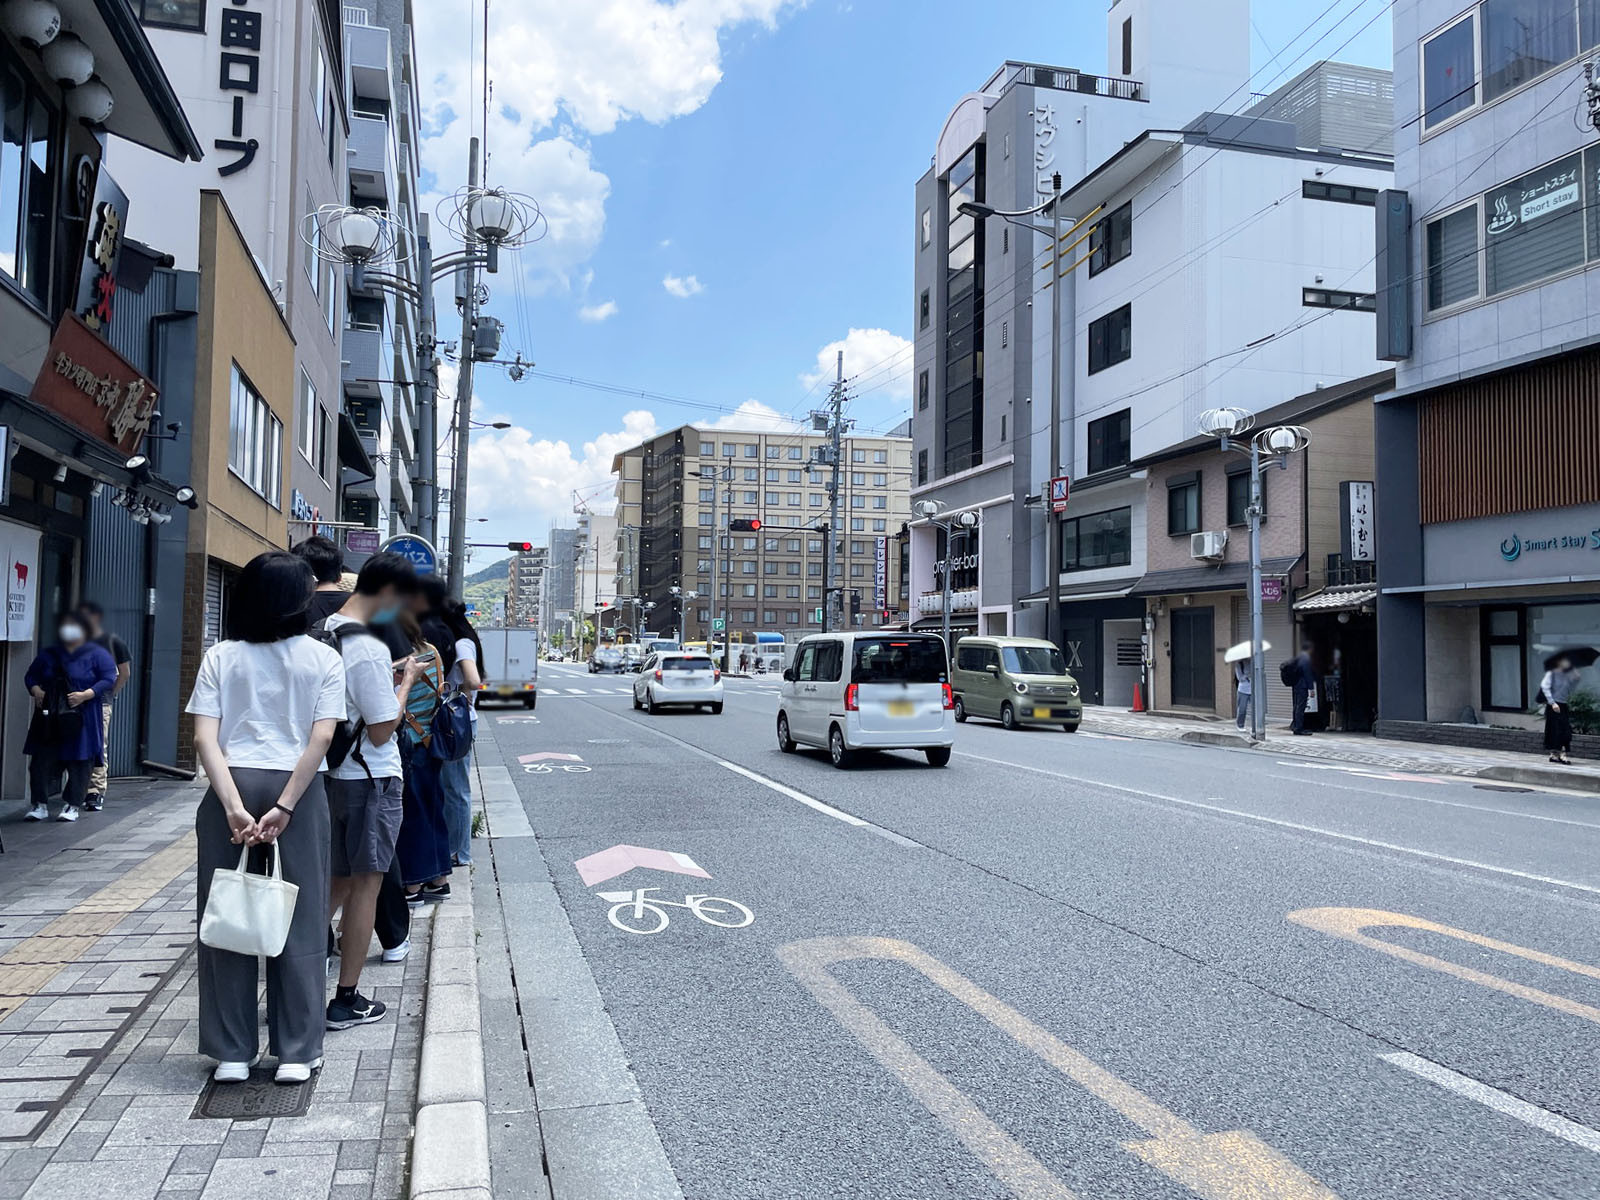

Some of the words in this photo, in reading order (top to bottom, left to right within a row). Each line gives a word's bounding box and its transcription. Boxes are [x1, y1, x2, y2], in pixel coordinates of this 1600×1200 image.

[214, 0, 262, 177] 田ロープ
[1521, 169, 1576, 201] ショートステイ
[1524, 200, 1550, 216] Short
[1553, 190, 1574, 205] stay
[1524, 538, 1558, 551] Smart
[1561, 536, 1586, 549] Stay
[932, 552, 979, 578] preier-bar
